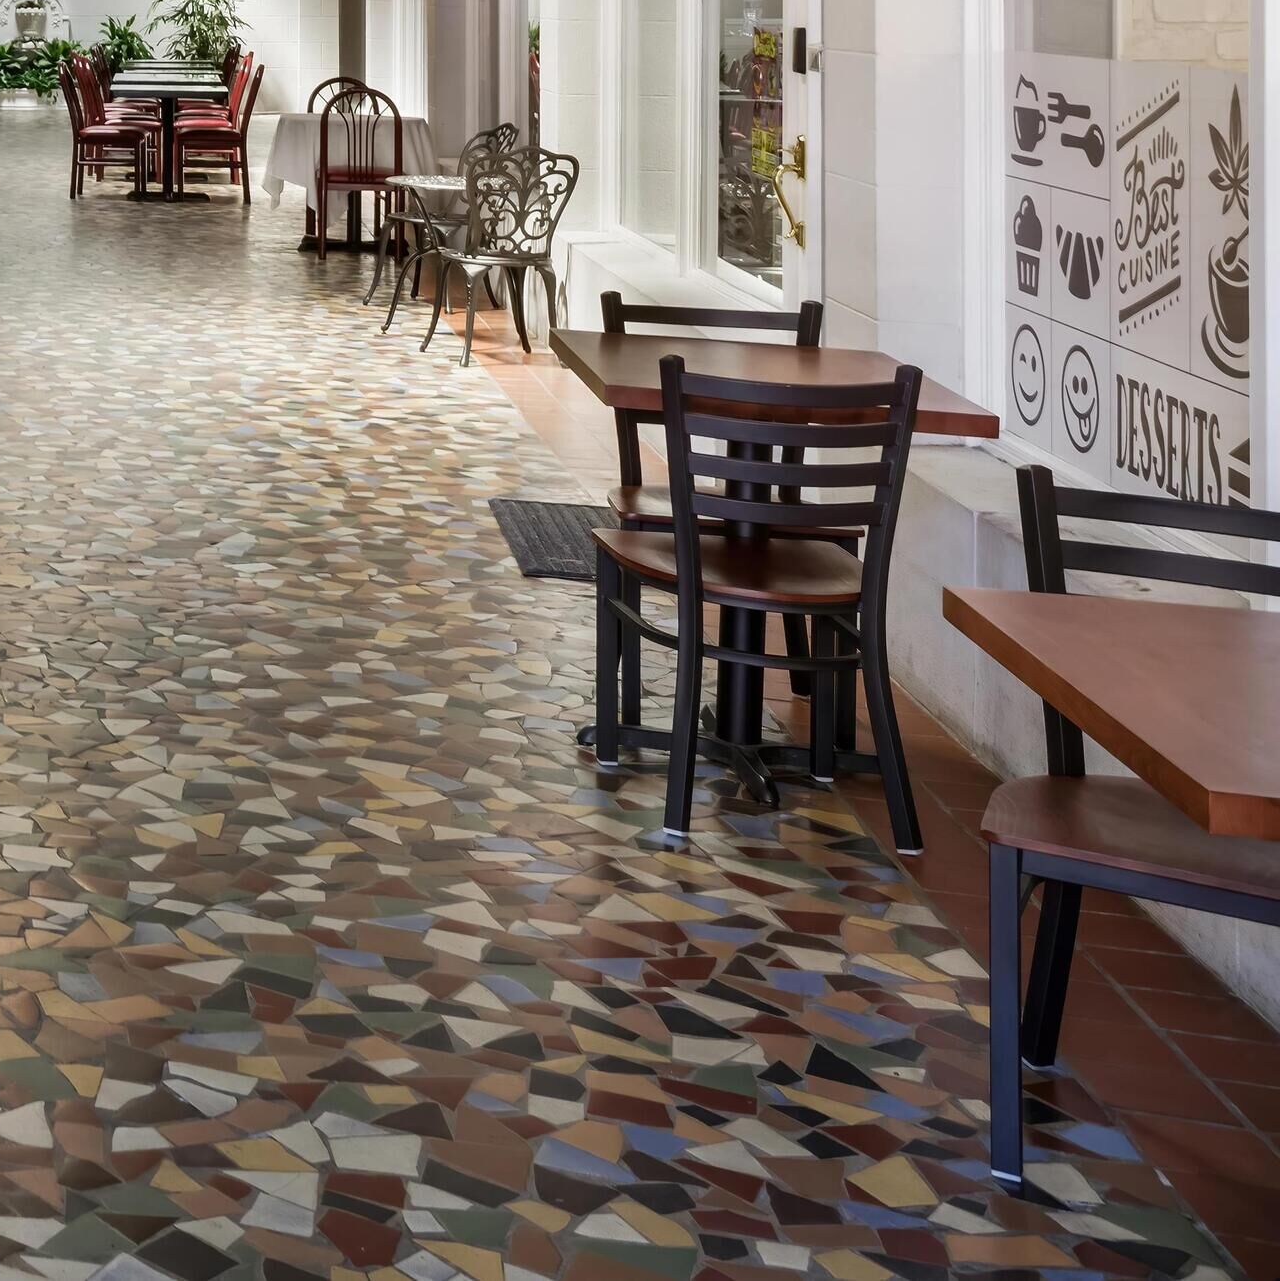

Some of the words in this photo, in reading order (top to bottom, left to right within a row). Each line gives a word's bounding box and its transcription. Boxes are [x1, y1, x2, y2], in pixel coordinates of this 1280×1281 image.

[1115, 145, 1185, 252] Best
[1117, 229, 1182, 295] CUISINE
[1115, 373, 1222, 505] DESSERTS
